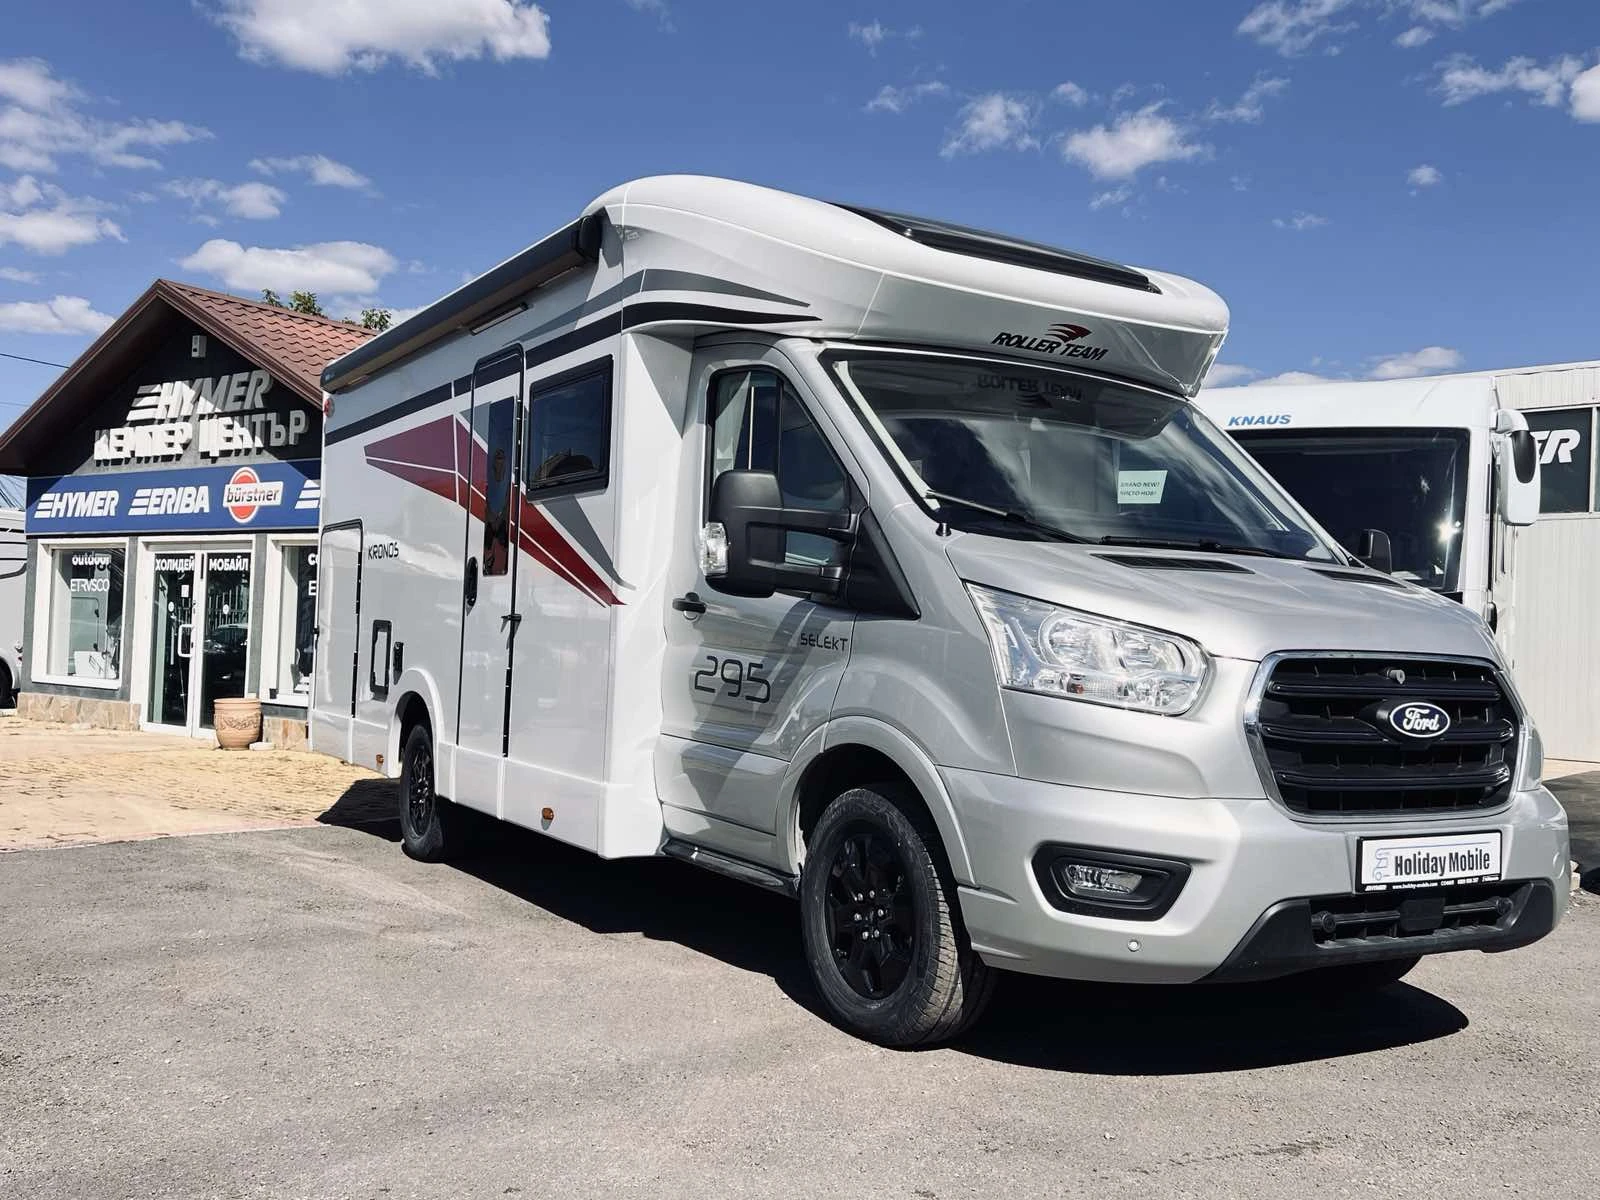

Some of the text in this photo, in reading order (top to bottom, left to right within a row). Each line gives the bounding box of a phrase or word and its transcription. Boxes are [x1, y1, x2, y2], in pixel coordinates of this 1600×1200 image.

[991, 332, 1109, 361] ROLLER TEAM
[154, 370, 271, 419] HYMER
[1228, 414, 1292, 426] KNAUS
[50, 490, 119, 518] HYMER
[146, 486, 210, 515] ERIBA
[227, 486, 280, 504] bürstner
[155, 555, 249, 573] ХОЛИДЕЙ МОБАЙЛ
[368, 542, 399, 560] KRONOS
[800, 632, 848, 651] SELEKT
[694, 655, 771, 704] 295
[1402, 706, 1440, 732] Ford
[1394, 847, 1490, 877] Holiday Mobile
